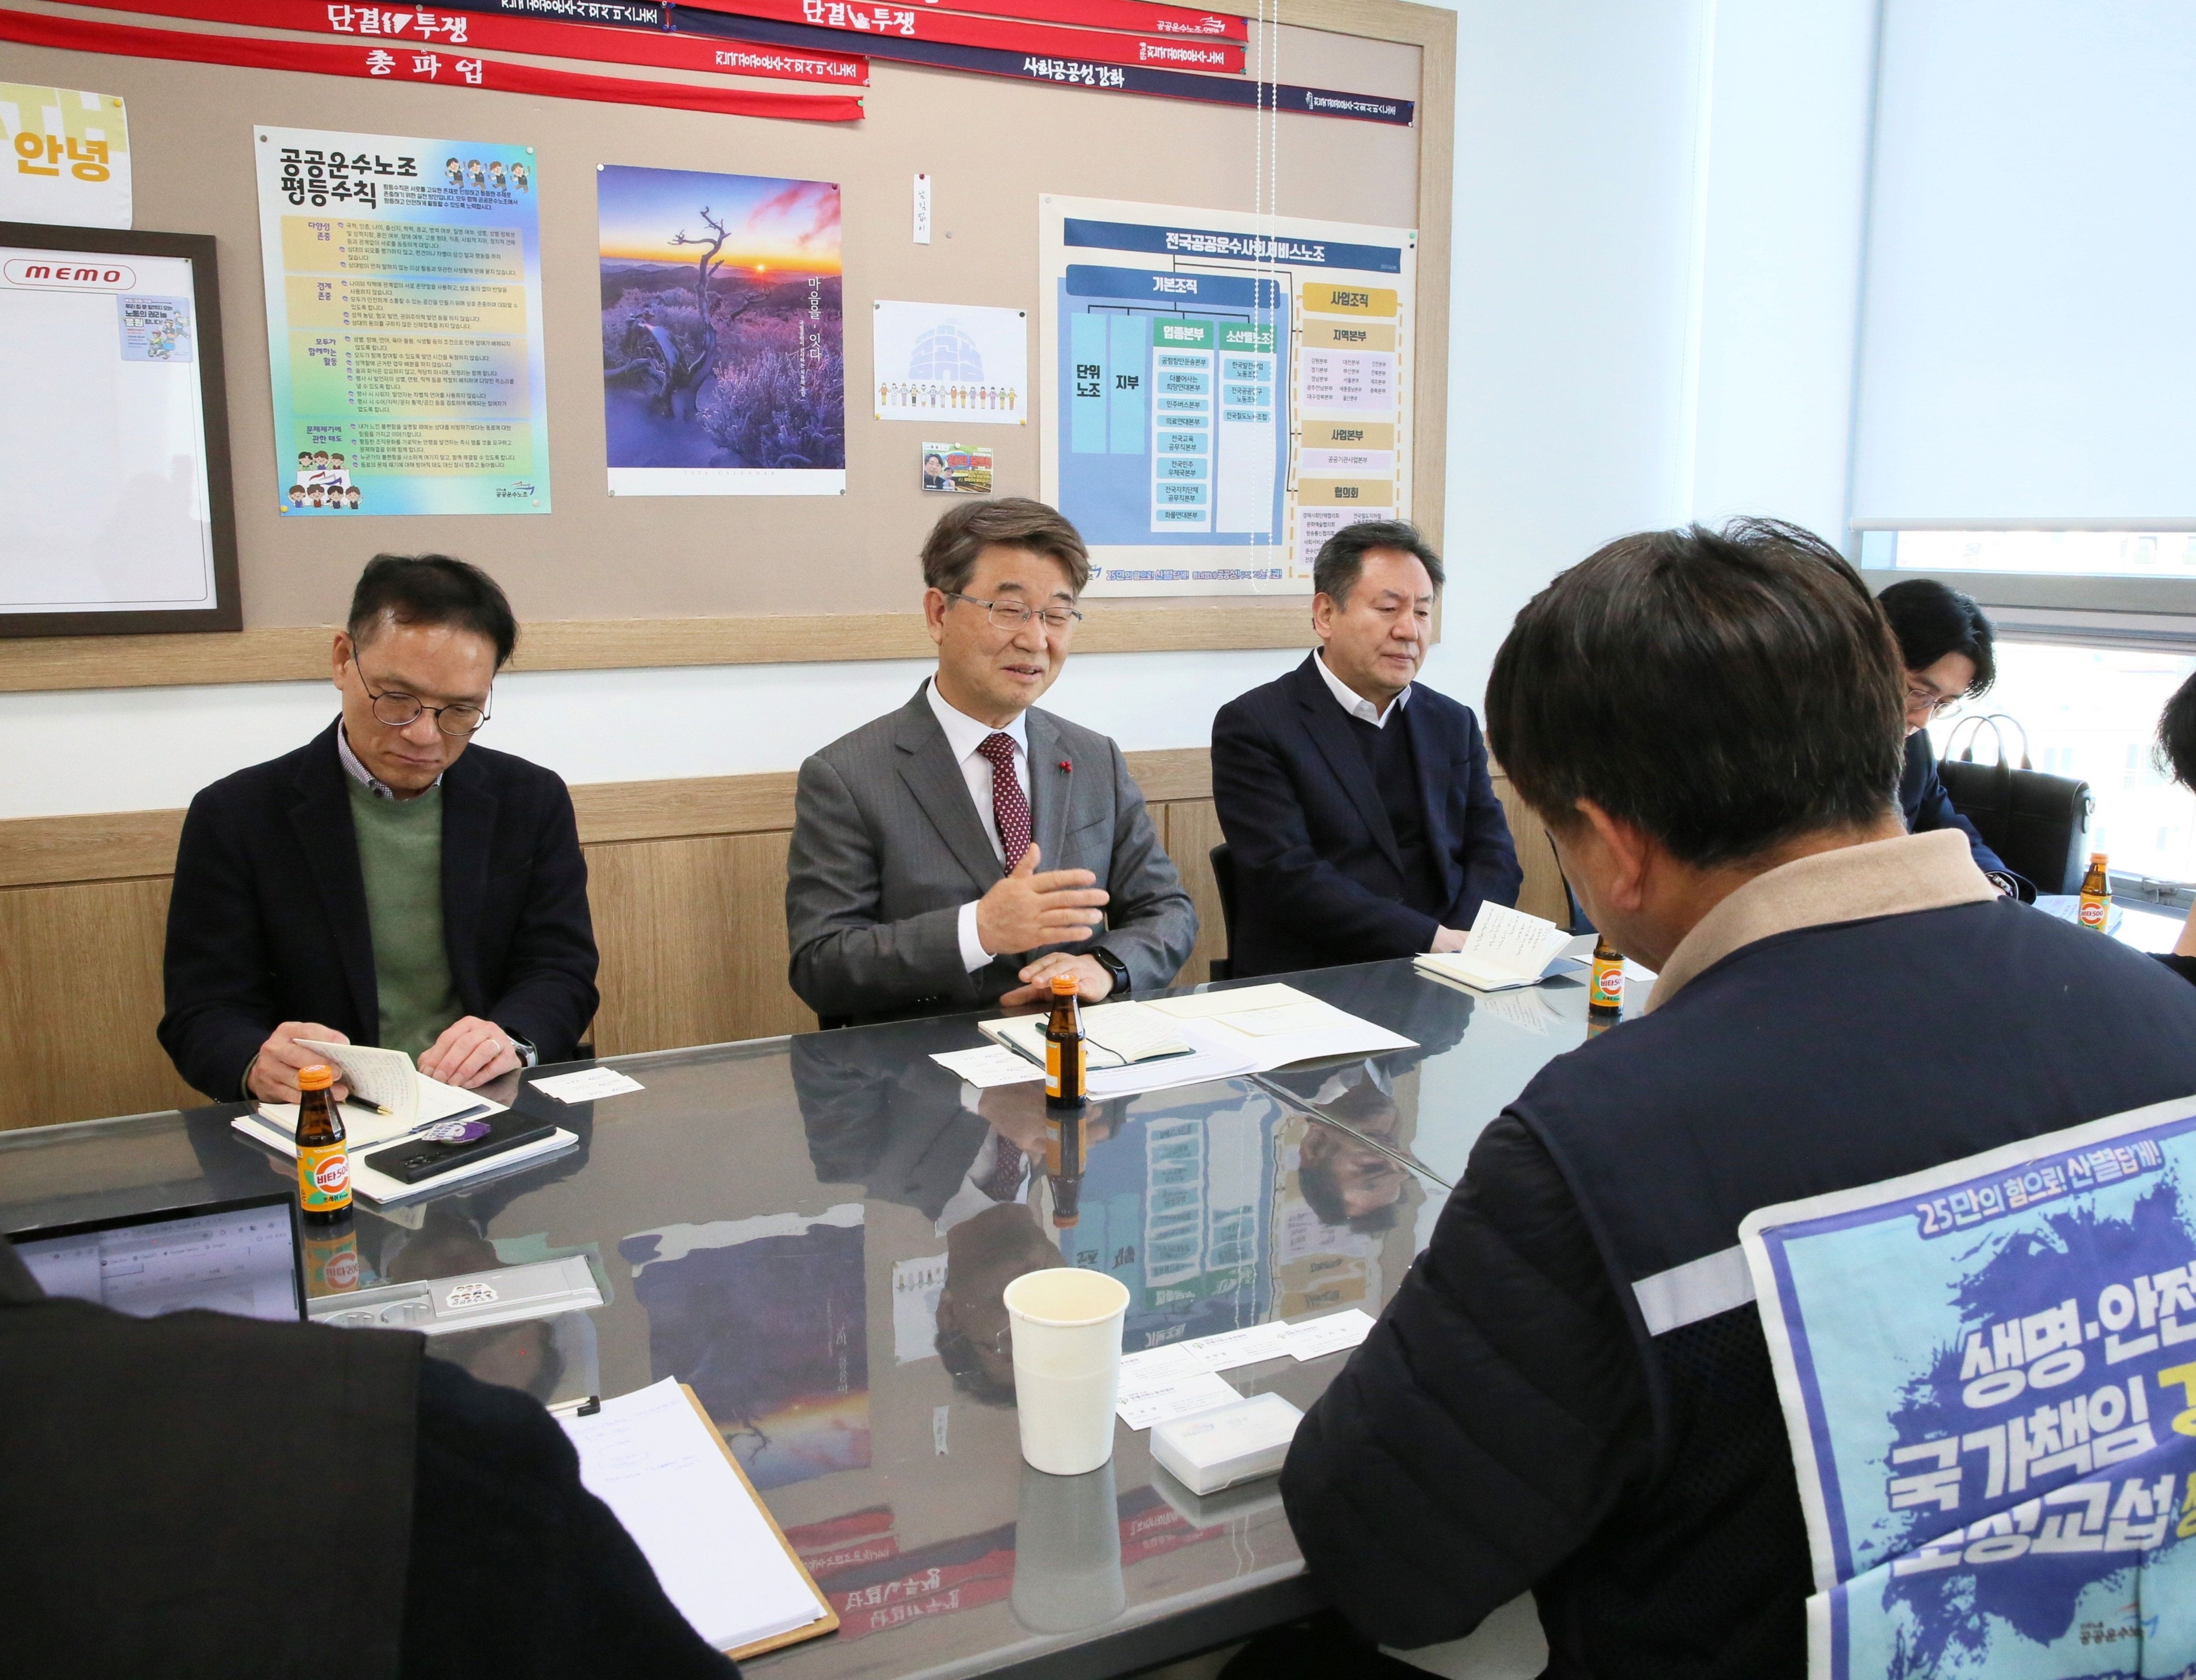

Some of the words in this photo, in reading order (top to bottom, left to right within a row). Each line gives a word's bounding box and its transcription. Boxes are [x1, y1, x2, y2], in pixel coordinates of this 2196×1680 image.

[328, 4, 383, 34] 단결
[413, 13, 469, 43] 투쟁
[803, 0, 846, 26] 단결
[871, 8, 916, 35] 투쟁
[716, 51, 857, 78] 전국공공운수사회서비스노조
[1023, 56, 1096, 84] 사회공공성
[1099, 65, 1125, 88] 강화
[14, 132, 111, 182] 안녕
[280, 148, 418, 180] 공공운수노조
[281, 178, 377, 210] 평등수칙
[308, 221, 331, 231] 다양성
[317, 231, 331, 241] 존중
[1165, 231, 1326, 262] 전국공공운수사회서비스노조
[25, 265, 121, 283] MEMO
[1152, 276, 1198, 295] 기본조직
[318, 292, 332, 301] 존중
[808, 276, 822, 320] 마음을
[1330, 290, 1369, 308] 사업조직
[125, 317, 144, 327] 응원
[1163, 325, 1205, 341] 업종본부
[1225, 330, 1271, 344] 소산별노조
[1333, 329, 1367, 342] 지역본부
[308, 347, 337, 357] 함께하는
[809, 332, 822, 362] 잇다
[323, 357, 338, 366] 활동
[1161, 357, 1206, 367] 공항항만운송본부
[1076, 364, 1101, 380] 단위
[1115, 374, 1139, 390] 지부
[1169, 374, 1199, 384] 더불어사는
[1076, 382, 1101, 398] 노조
[1166, 382, 1201, 392] 희망연대본부
[1166, 400, 1201, 409] 민주버스본부
[1165, 417, 1200, 426] 의료연대본부
[306, 425, 342, 434] 문제제기에
[1331, 429, 1364, 441] 사업본부
[312, 435, 327, 444] 관한
[1171, 434, 1194, 443] 전국교육
[1168, 443, 1197, 452] 공무직본부
[1168, 469, 1196, 477] 우체국본부
[1165, 486, 1199, 494] 전국자치단체
[1334, 486, 1359, 498] 협의회
[1168, 494, 1196, 502] 공무직본부
[1164, 511, 1198, 519] 화물연대본부
[1106, 570, 1133, 581] 25만의
[1133, 570, 1155, 581] 힘으로!
[1155, 569, 1189, 581] 산별답게!
[317, 1163, 349, 1185] 비타500
[1916, 1184, 2006, 1234] 25만의
[2004, 1166, 2068, 1209] 힘으로!
[2068, 1140, 2163, 1190] 산별답게!
[1890, 1375, 2158, 1512] 국가책임
